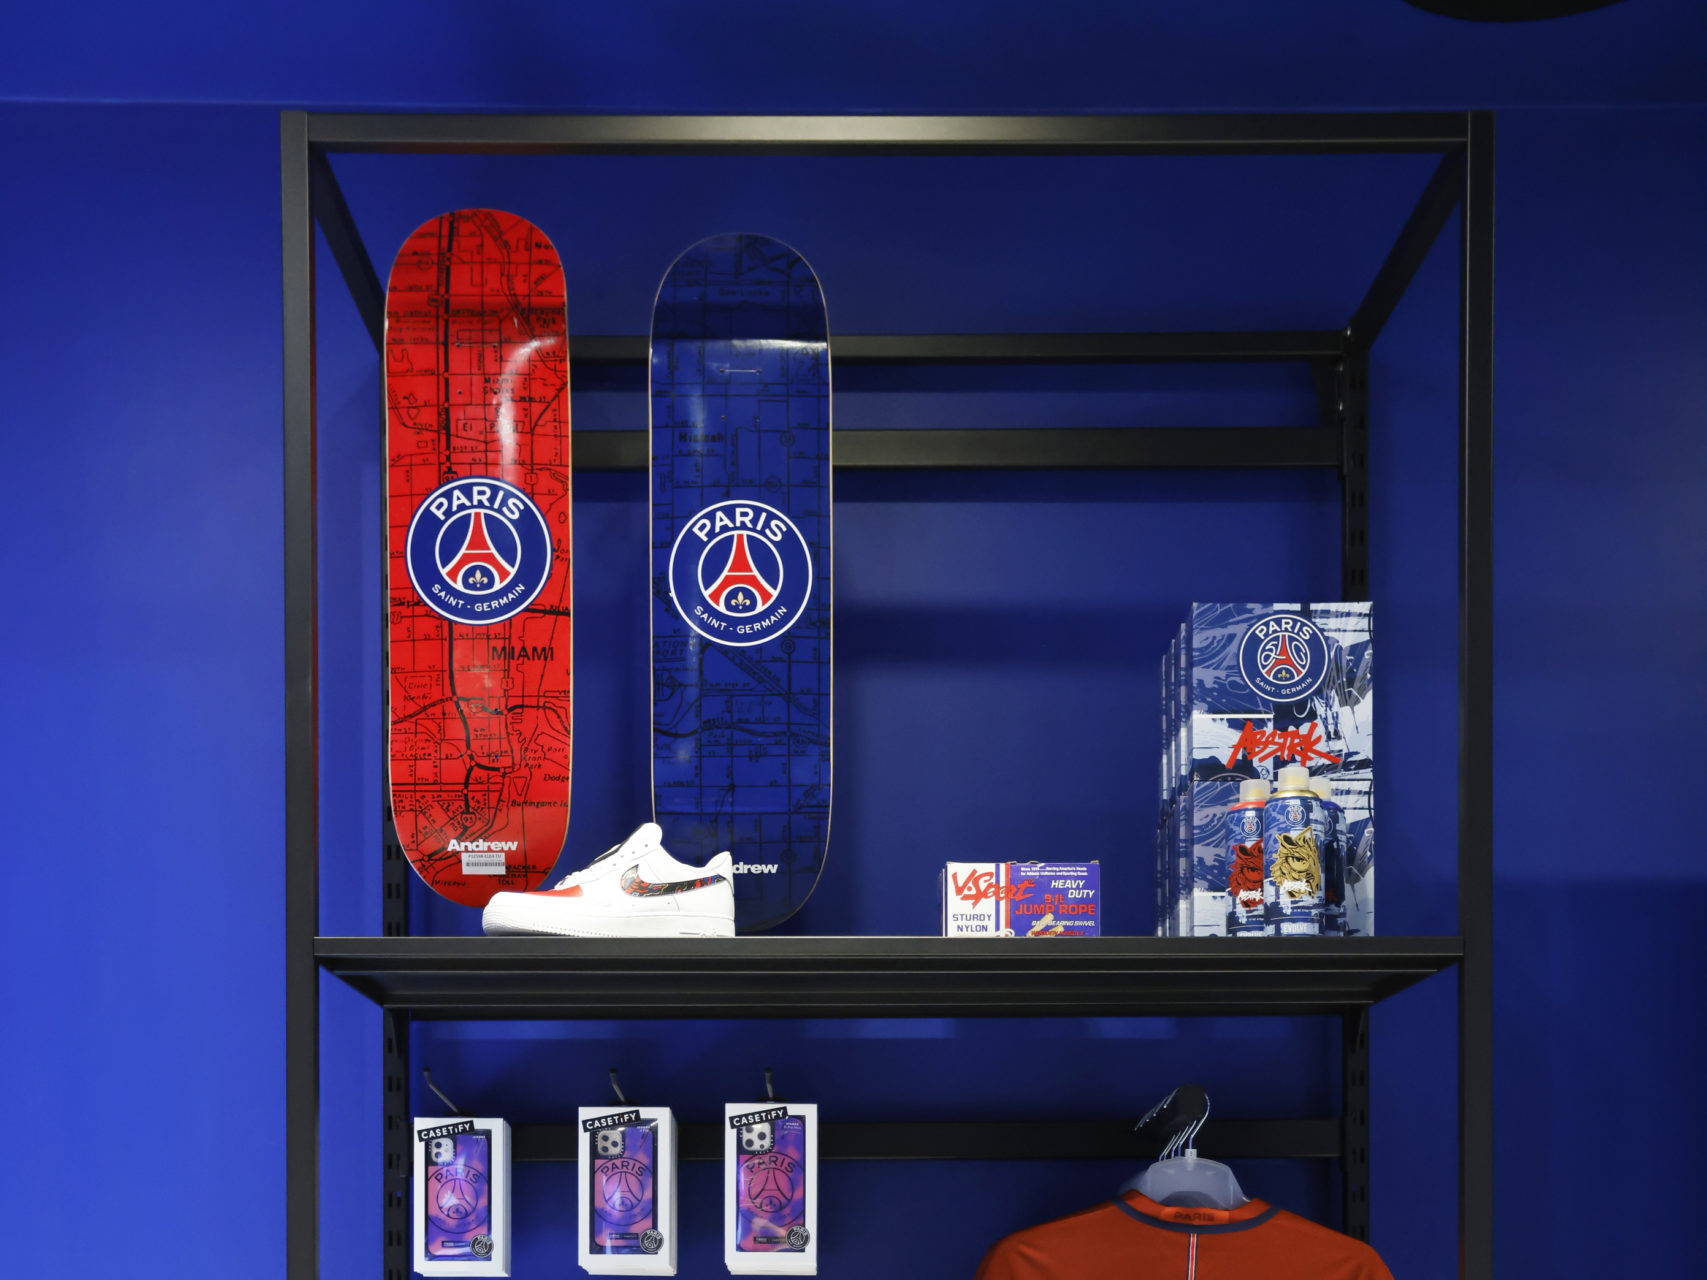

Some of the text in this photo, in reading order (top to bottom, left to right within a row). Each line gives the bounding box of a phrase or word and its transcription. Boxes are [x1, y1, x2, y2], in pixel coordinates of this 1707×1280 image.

[429, 486, 525, 521] PARIS
[692, 507, 787, 542] PARIS
[432, 583, 465, 609] SAINT
[474, 583, 526, 612] GERMAIN
[694, 605, 727, 631] SAINT
[737, 605, 788, 634] GERMAIN
[1255, 619, 1313, 640] PARIS
[491, 646, 554, 661] MIAMI
[1255, 677, 1275, 693] SAINT
[1281, 677, 1313, 694] GERMAIN
[1226, 720, 1342, 769] ABSTRK
[447, 839, 518, 851] Andrew
[733, 862, 778, 874] drew
[1051, 880, 1085, 888] HEAVY
[1068, 889, 1095, 898] DUTY
[952, 913, 992, 921] STURDY
[1015, 904, 1096, 915] JUMP ROPE
[957, 924, 988, 932] NYLON
[600, 1160, 646, 1177] PARIS
[746, 1155, 796, 1174] PARIS
[434, 1169, 481, 1184] PARIS
[1173, 1211, 1215, 1222] PARIS
